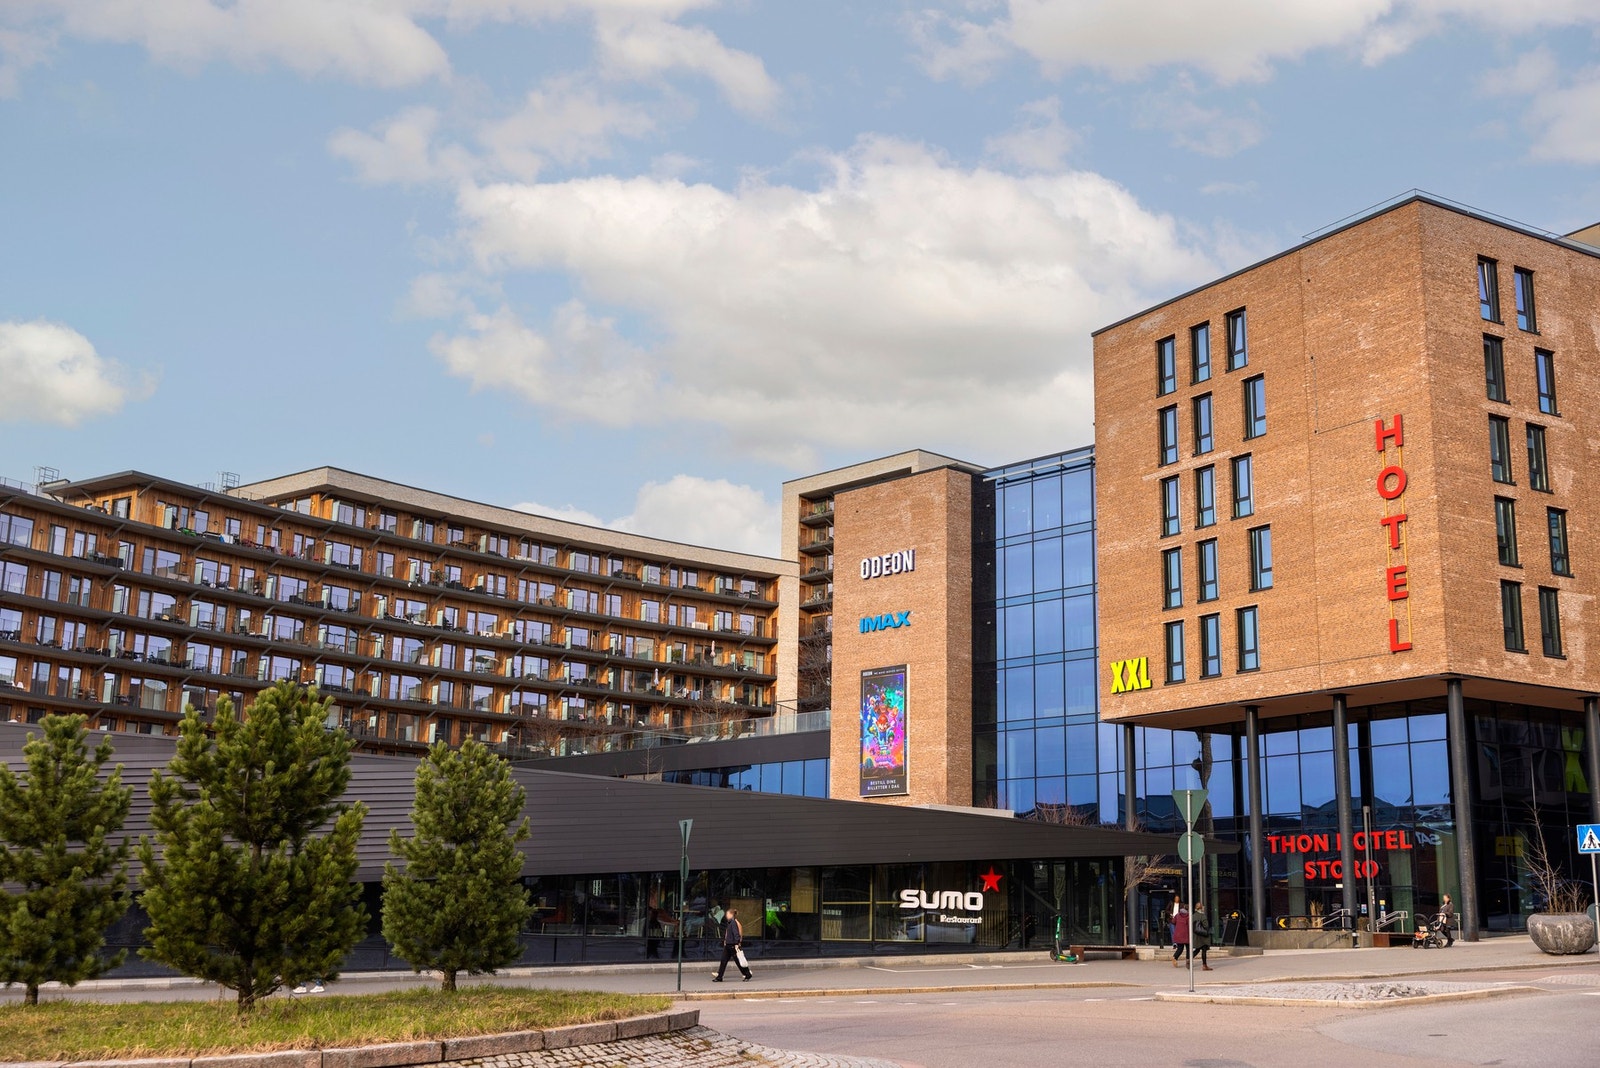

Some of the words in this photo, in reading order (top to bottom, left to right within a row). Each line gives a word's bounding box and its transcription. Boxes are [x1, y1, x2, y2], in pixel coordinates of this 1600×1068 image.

[1375, 413, 1412, 653] HOTEL
[860, 549, 915, 580] ODEON
[859, 610, 911, 633] IMAX
[1110, 656, 1152, 694] XXL
[1267, 834, 1330, 853] THON
[899, 888, 984, 911] SUMO
[940, 914, 982, 924] Restaurant
